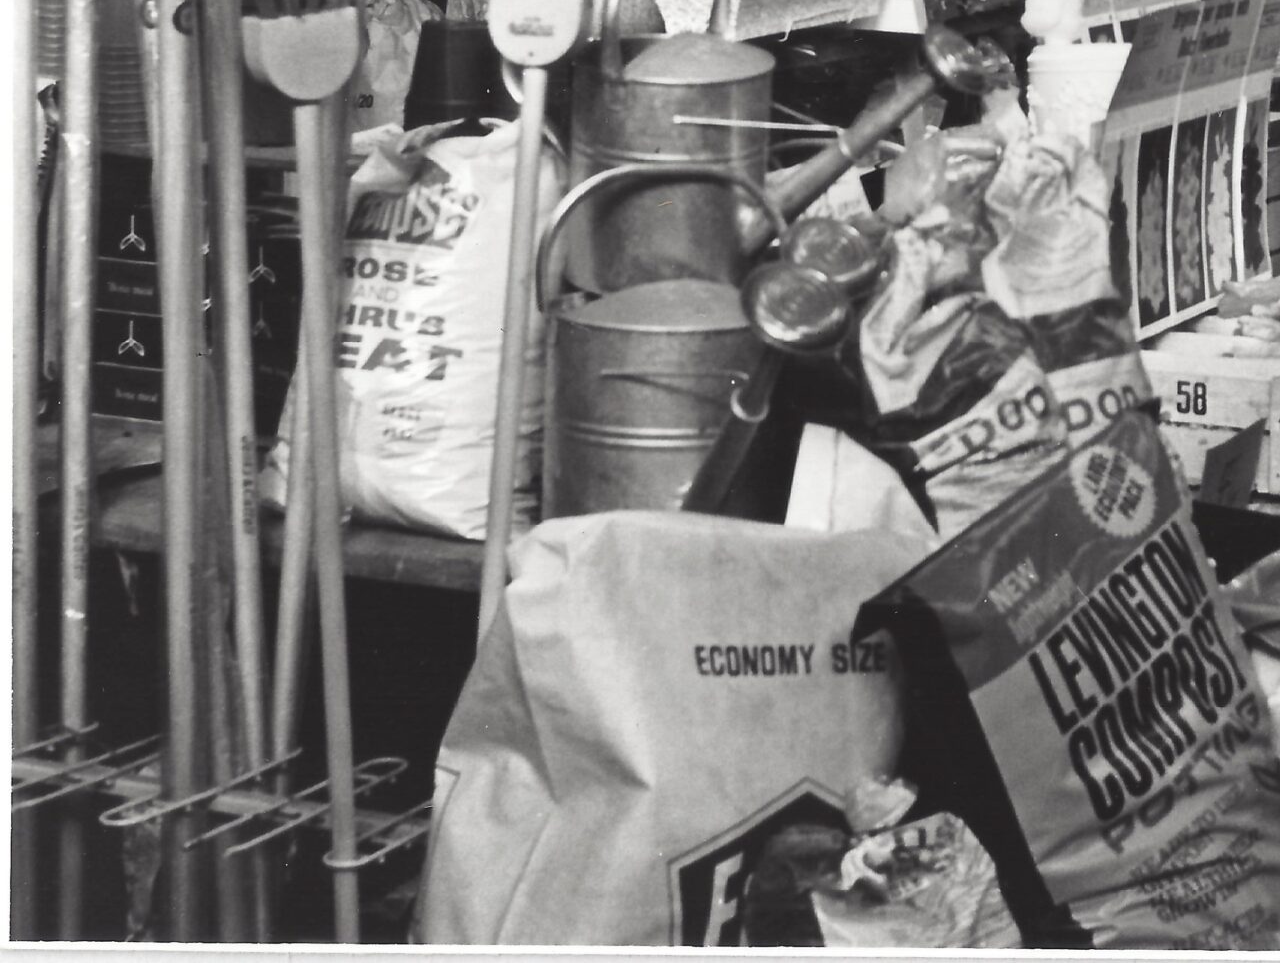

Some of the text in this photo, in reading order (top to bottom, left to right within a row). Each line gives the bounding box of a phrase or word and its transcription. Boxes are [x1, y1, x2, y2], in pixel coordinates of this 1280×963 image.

[335, 334, 463, 381] EAT
[1176, 380, 1208, 416] 58
[1028, 520, 1208, 736] LEVINGTON
[695, 642, 886, 676] ECONOMY SIZE
[1069, 600, 1247, 821] COMPOST
